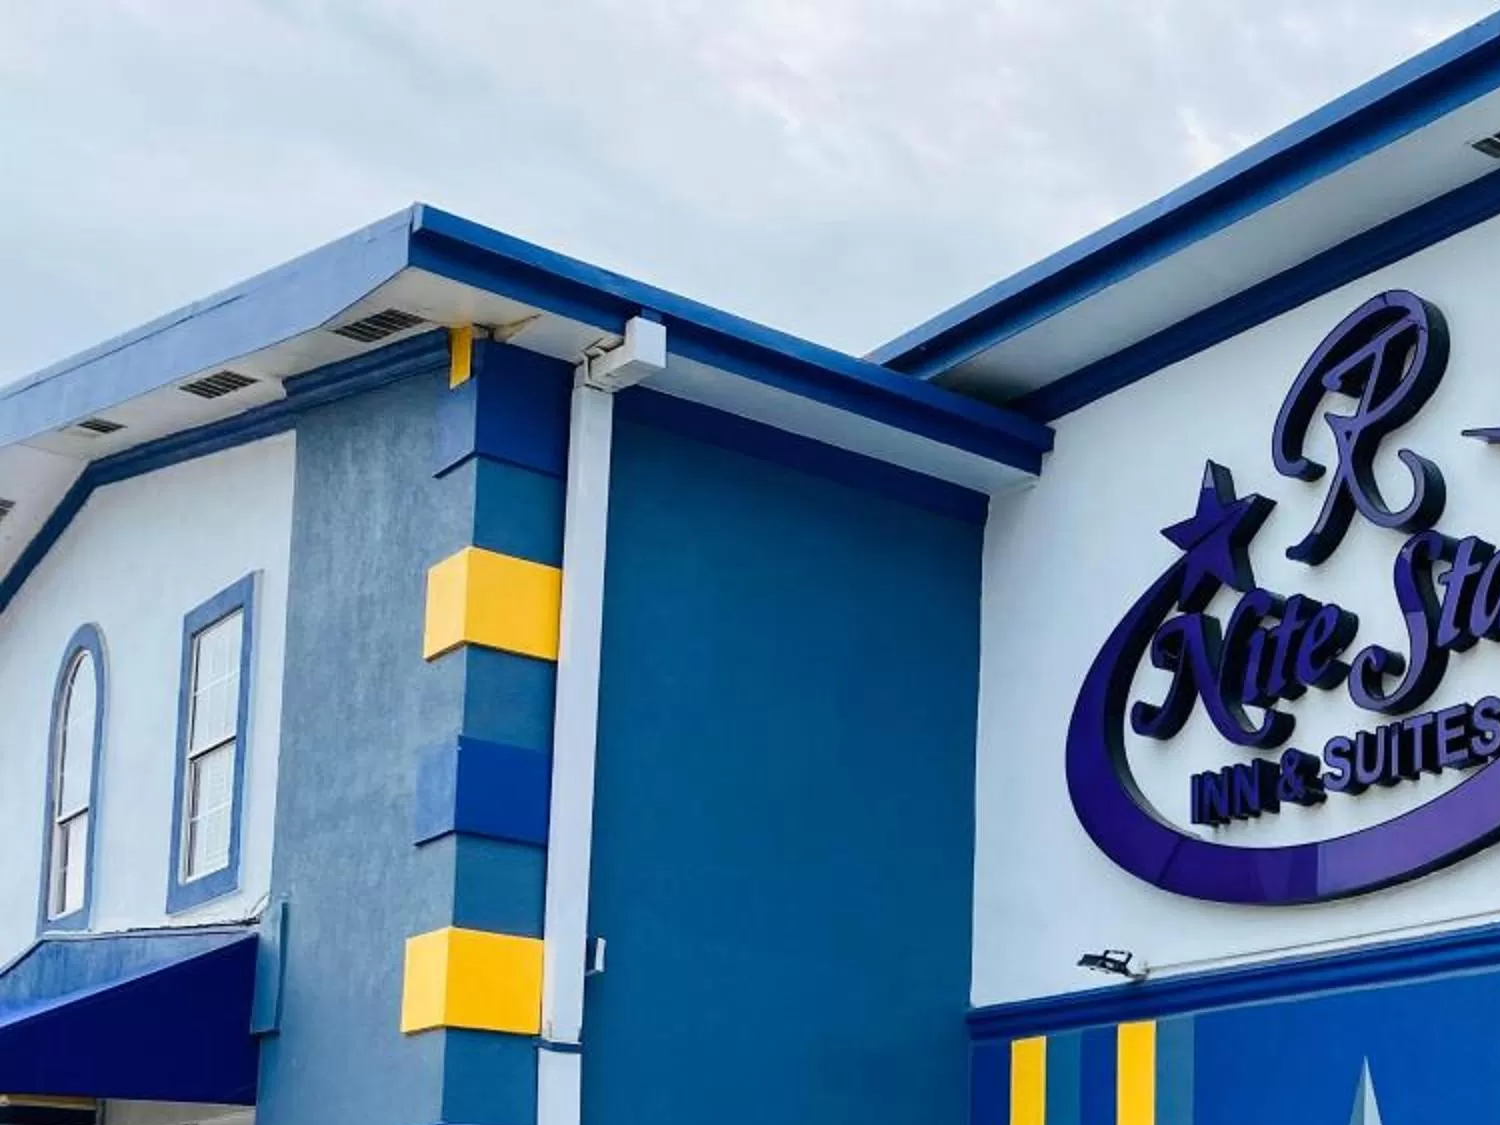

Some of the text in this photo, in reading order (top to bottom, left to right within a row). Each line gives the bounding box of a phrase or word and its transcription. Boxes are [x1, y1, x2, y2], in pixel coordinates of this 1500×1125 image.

[1131, 587, 1359, 748] Nite
[1191, 757, 1280, 826] INN
[1276, 747, 1327, 807] &
